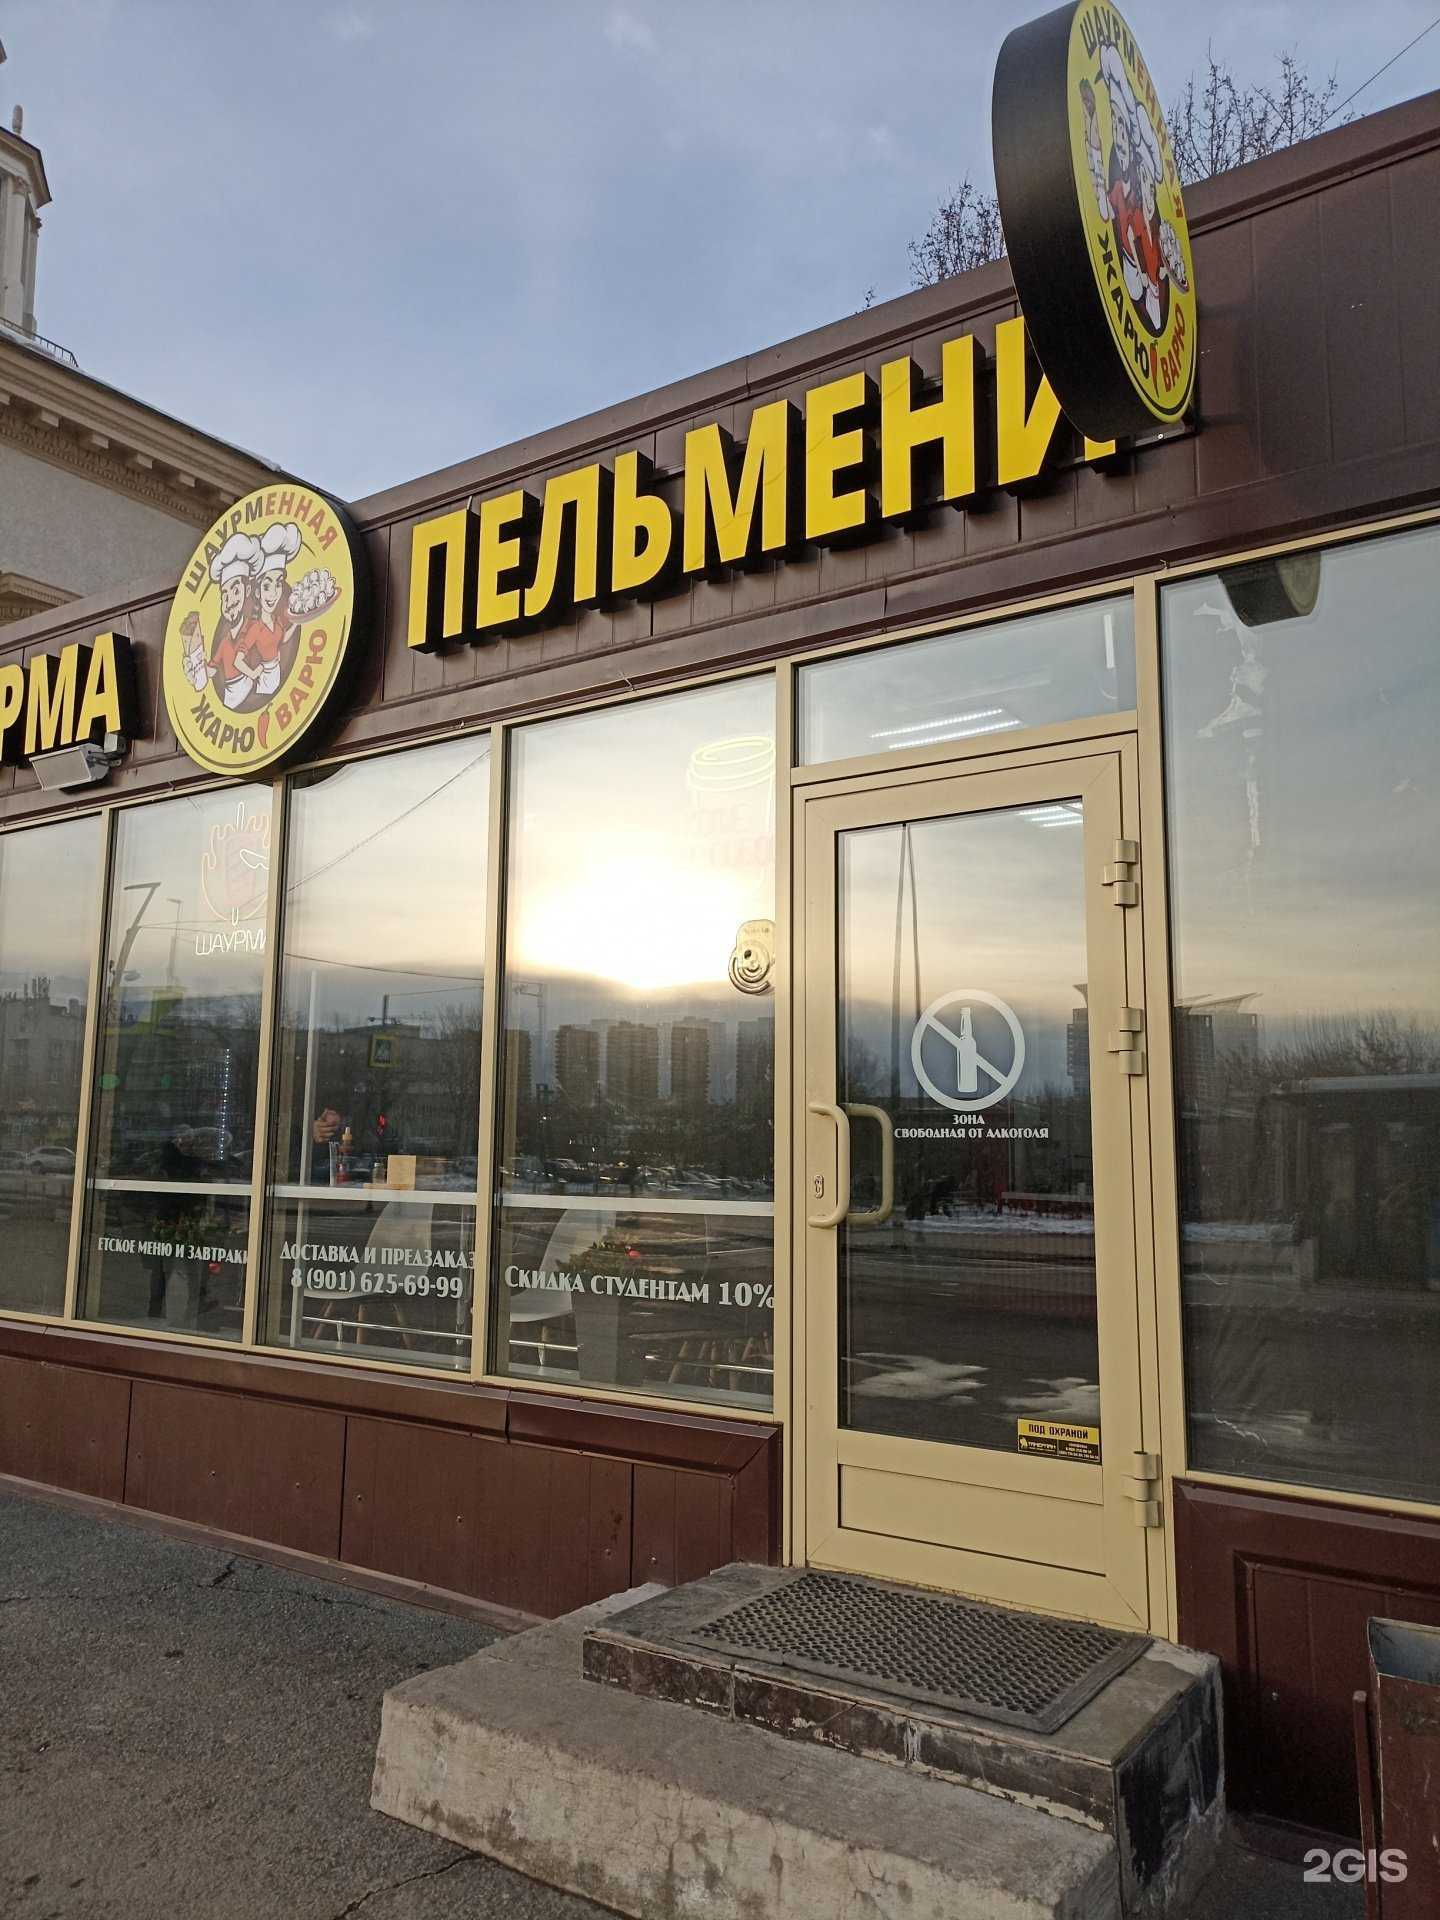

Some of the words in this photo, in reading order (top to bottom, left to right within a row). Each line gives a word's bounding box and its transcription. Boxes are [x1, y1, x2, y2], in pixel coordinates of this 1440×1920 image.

[1098, 230, 1149, 380] ЖАРЮ
[1160, 303, 1185, 392] ВАРЮ
[186, 492, 340, 594] ШАУРМЕННАЯ
[0, 632, 121, 762] РМА
[190, 694, 256, 754] ЖАРЮ
[276, 628, 328, 731] ВАРЮ
[195, 928, 267, 956] ШАУРМ
[894, 1128, 966, 1139] СВОБОДНАЯ
[968, 1128, 984, 1139] ОТ
[986, 1128, 1049, 1139] АЛКОГОЛЯ
[952, 1114, 985, 1125] ЗОНА
[138, 1240, 172, 1257] МЕНЮ
[175, 1243, 185, 1258] И
[280, 1241, 359, 1264] ДОСТАВКА
[364, 1246, 376, 1265] И
[381, 1247, 475, 1269] ПРЕДЗАКАЗ
[290, 1268, 303, 1288] 8
[306, 1269, 356, 1293] (901)
[360, 1272, 463, 1299] 625-69-99
[591, 1275, 709, 1304] СТУДЕНТАМ
[718, 1281, 775, 1309] 10%
[1028, 1423, 1045, 1435] ПОД
[1049, 1426, 1089, 1440] ОХРАНОЙ
